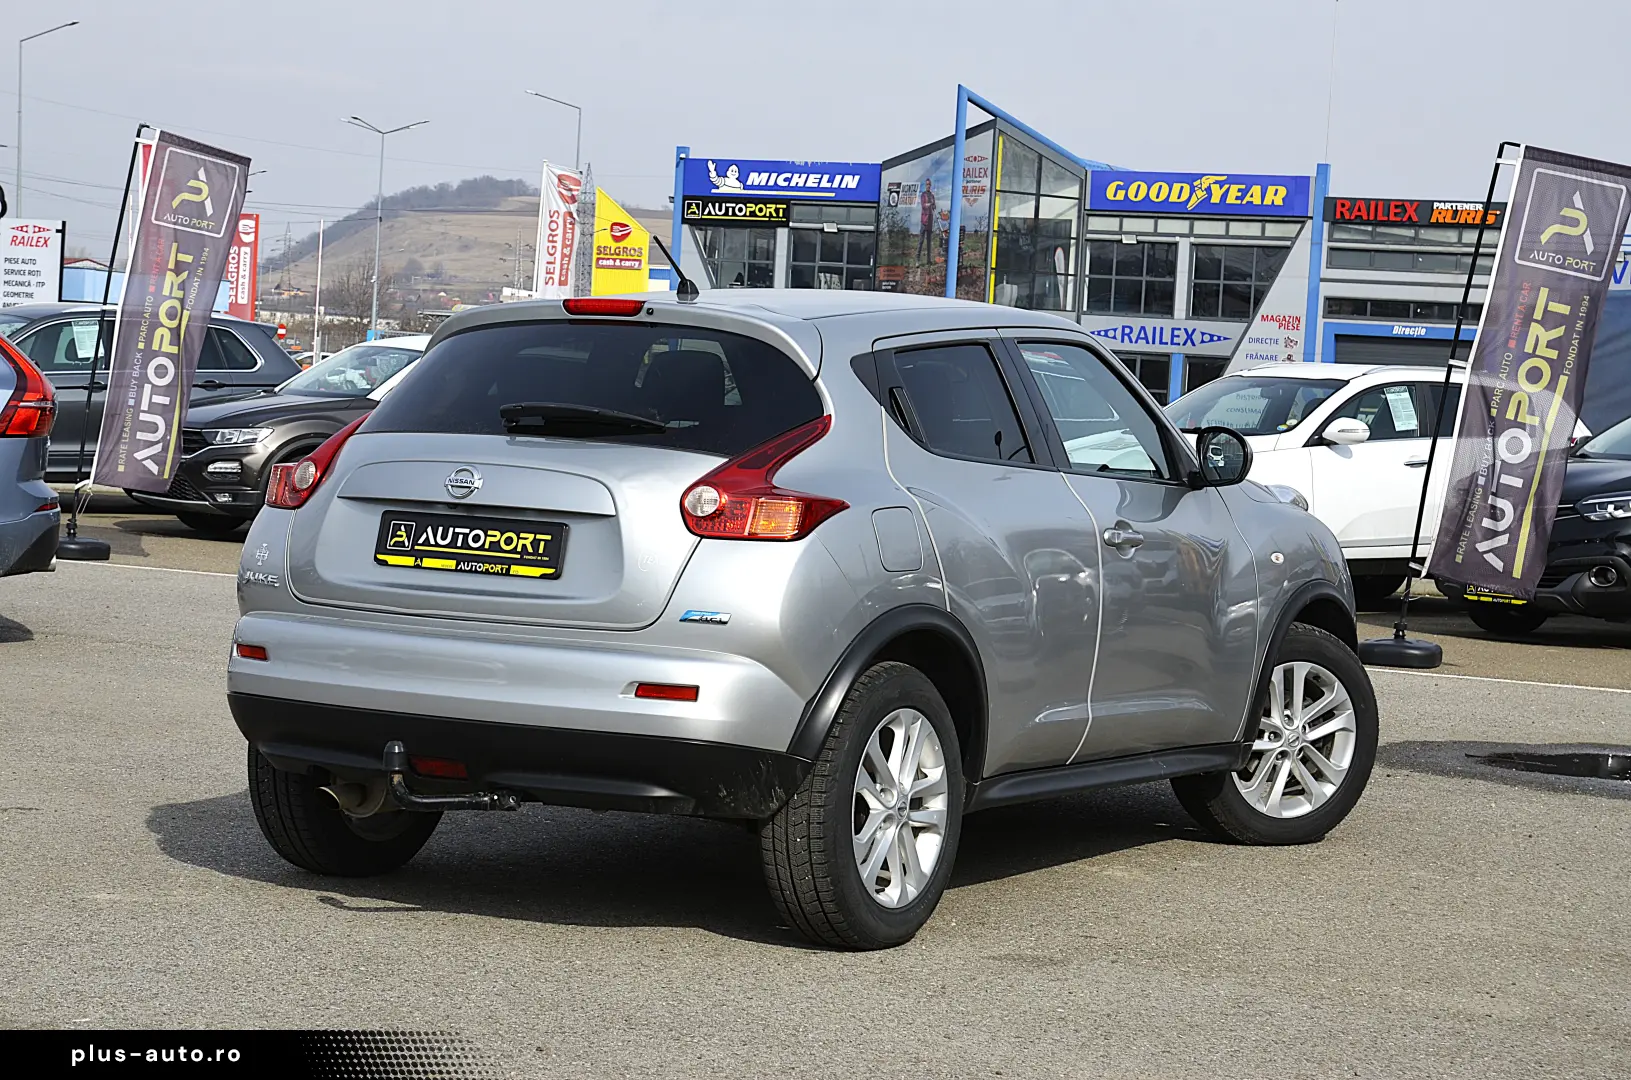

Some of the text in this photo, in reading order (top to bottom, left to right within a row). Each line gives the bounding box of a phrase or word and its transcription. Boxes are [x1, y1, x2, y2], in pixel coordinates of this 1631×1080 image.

[746, 172, 861, 189] MICHELIN
[703, 202, 787, 218] AUTOPORT
[1335, 199, 1419, 222] RAILEX
[1433, 201, 1484, 211] PARTENER
[163, 213, 216, 230] AUTO PORT
[10, 235, 51, 248] RAILEX
[545, 209, 560, 286] SELGROS
[560, 216, 575, 281] cash & carry
[595, 245, 643, 258] SELGROS
[4, 257, 37, 266] PIESE AUTO
[241, 250, 249, 271] carry
[598, 258, 614, 266] cash
[621, 260, 640, 268] carry
[1529, 249, 1597, 272] AUTO PORT
[186, 247, 210, 311] FONDAT IN 1994
[227, 245, 239, 304] SELGROS
[3, 291, 34, 299] GEOMETRIE
[138, 295, 153, 343] PARC AUTO
[1261, 314, 1301, 324] MAGAZIN
[1510, 313, 1523, 340] RENT
[1519, 282, 1532, 303] CAR
[1120, 324, 1197, 347] RAILEX
[1278, 322, 1301, 331] PIESE
[1563, 295, 1590, 375] FONDAT IN 1994
[133, 242, 194, 476] AUTOPORT
[128, 352, 143, 398] BUY BACK
[1491, 352, 1513, 409] PARC AUTO
[118, 408, 134, 465] RATE LEASING
[1475, 287, 1572, 573] AUTOPORT
[1480, 420, 1495, 476] BUY BACK
[448, 478, 475, 486] NISSAN
[1456, 487, 1483, 555] RATE LEASING
[417, 525, 552, 554] AUTOPORT
[243, 571, 280, 586] JUKE
[457, 562, 508, 574] AUTOPORT
